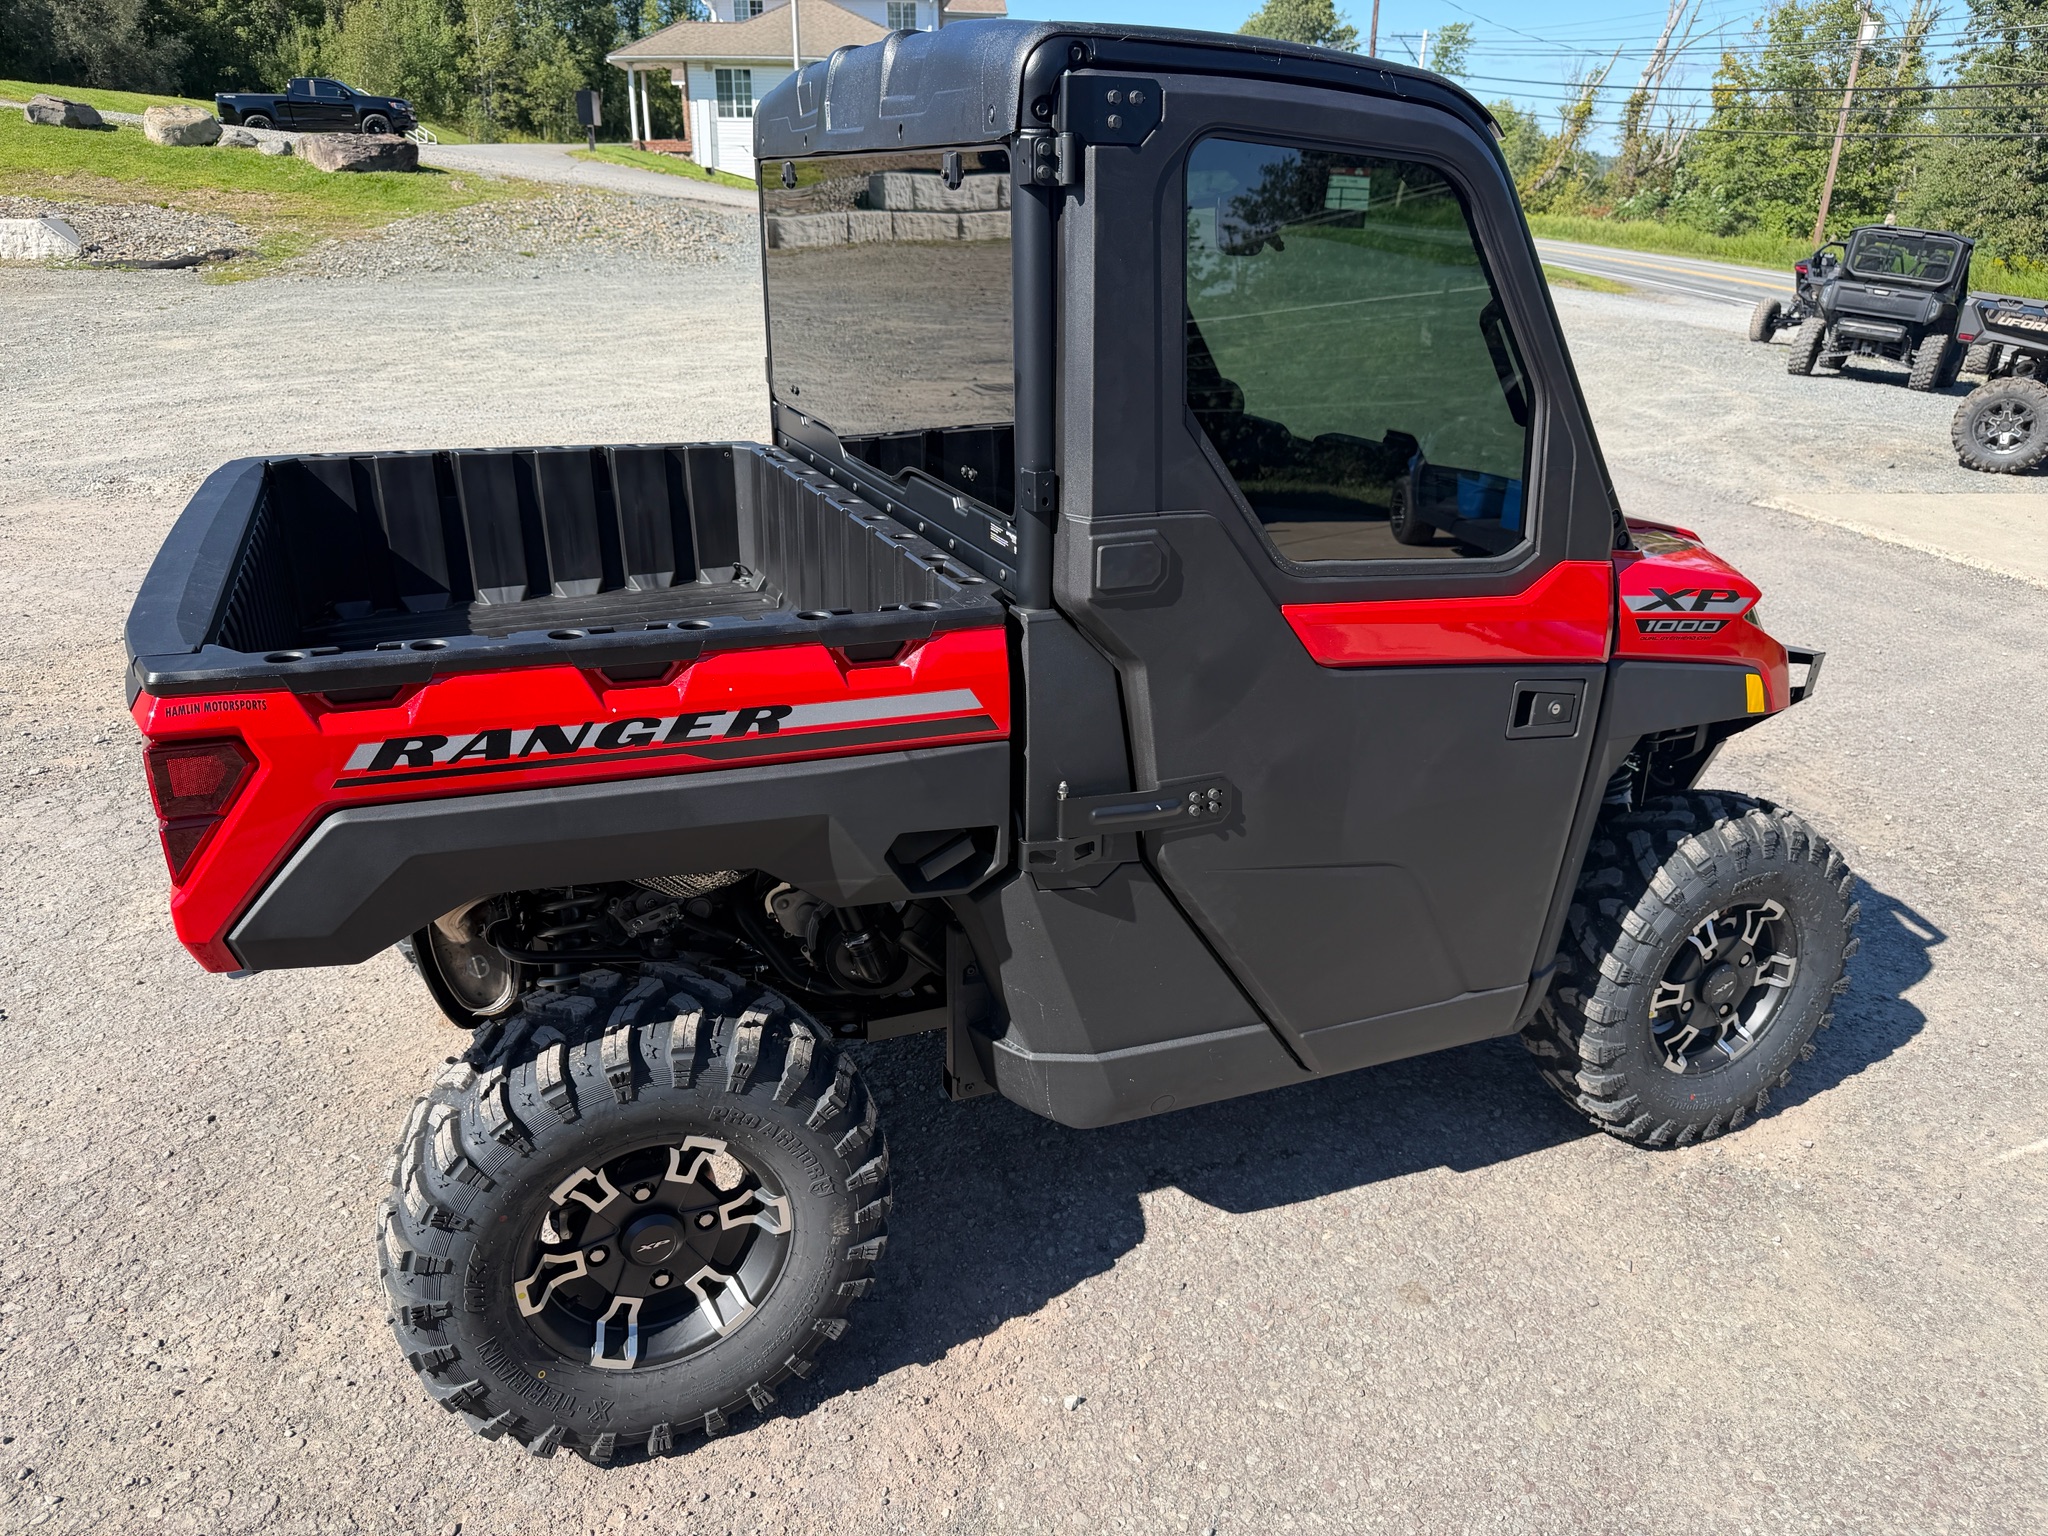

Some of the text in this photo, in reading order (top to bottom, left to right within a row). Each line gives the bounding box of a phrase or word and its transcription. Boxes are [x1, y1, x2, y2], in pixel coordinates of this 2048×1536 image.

[1634, 587, 1740, 612] XP
[1645, 620, 1722, 632] 1000
[165, 699, 267, 718] HAMLIN MOTORSPORTS
[366, 704, 792, 771] RANGER
[707, 1104, 826, 1182] PRO ARMOR
[636, 1239, 671, 1253] XP
[475, 1335, 615, 1422] X-TERRAIN
